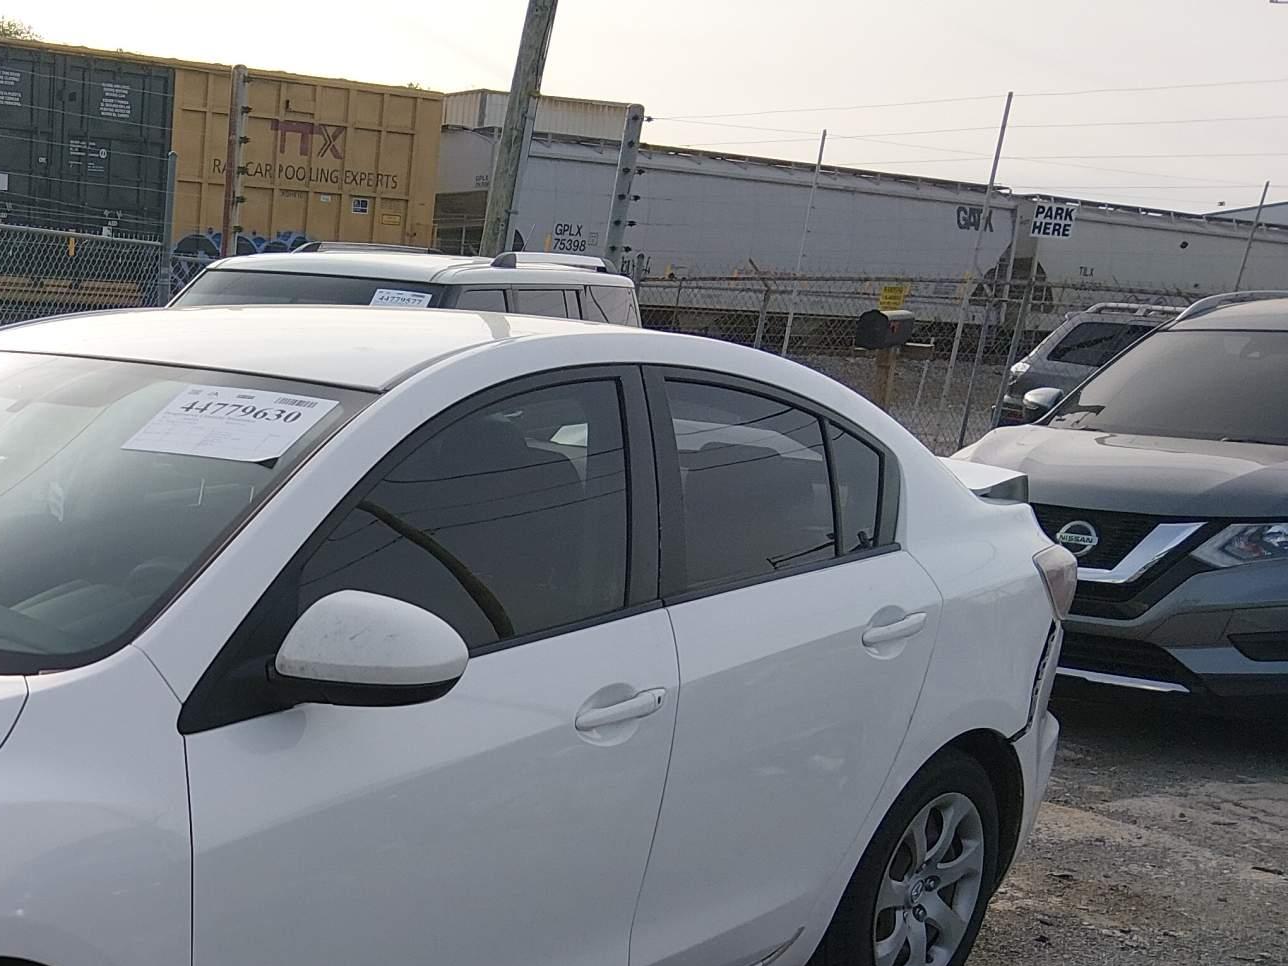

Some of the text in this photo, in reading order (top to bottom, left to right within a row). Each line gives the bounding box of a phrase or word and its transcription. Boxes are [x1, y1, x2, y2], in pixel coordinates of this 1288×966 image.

[270, 119, 348, 160] TTX
[278, 164, 339, 185] POOLING
[343, 170, 399, 189] EXPERTS
[1035, 205, 1075, 221] PARK
[554, 223, 583, 237] GPLX
[1031, 222, 1072, 237] HERE
[553, 238, 587, 252] 75398
[180, 400, 303, 424] 44779630
[1059, 534, 1093, 544] NISSAN
